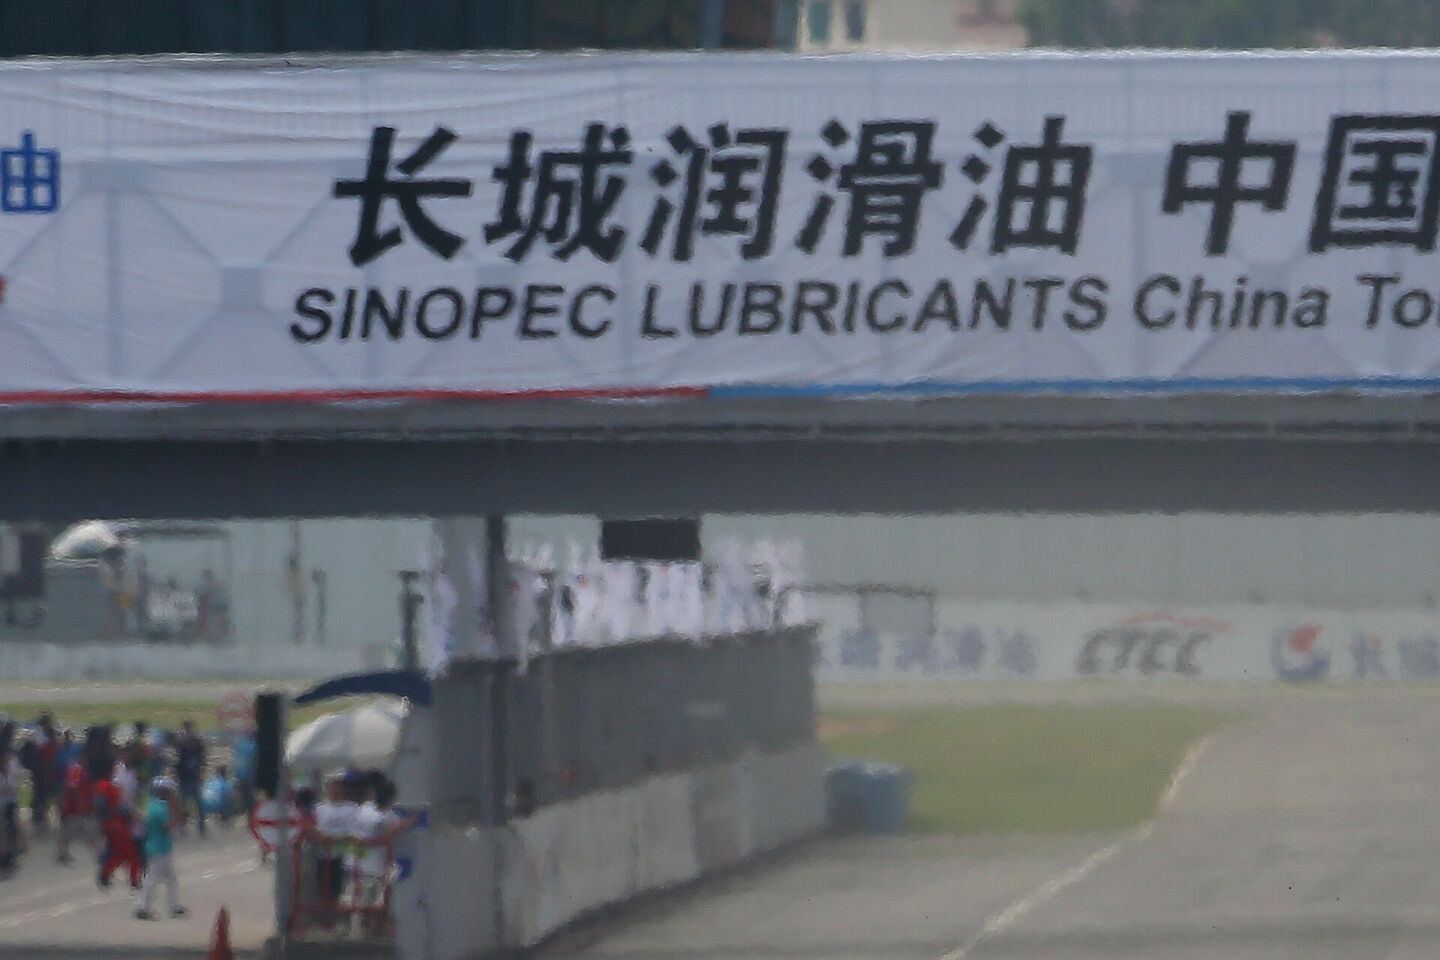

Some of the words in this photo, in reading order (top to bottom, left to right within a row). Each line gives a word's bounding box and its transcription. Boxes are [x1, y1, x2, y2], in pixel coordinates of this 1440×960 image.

[334, 113, 1093, 266] 长城润滑油
[290, 283, 617, 346] SINOPEC
[638, 276, 1109, 338] LUBRICANTS
[1133, 272, 1329, 331] China
